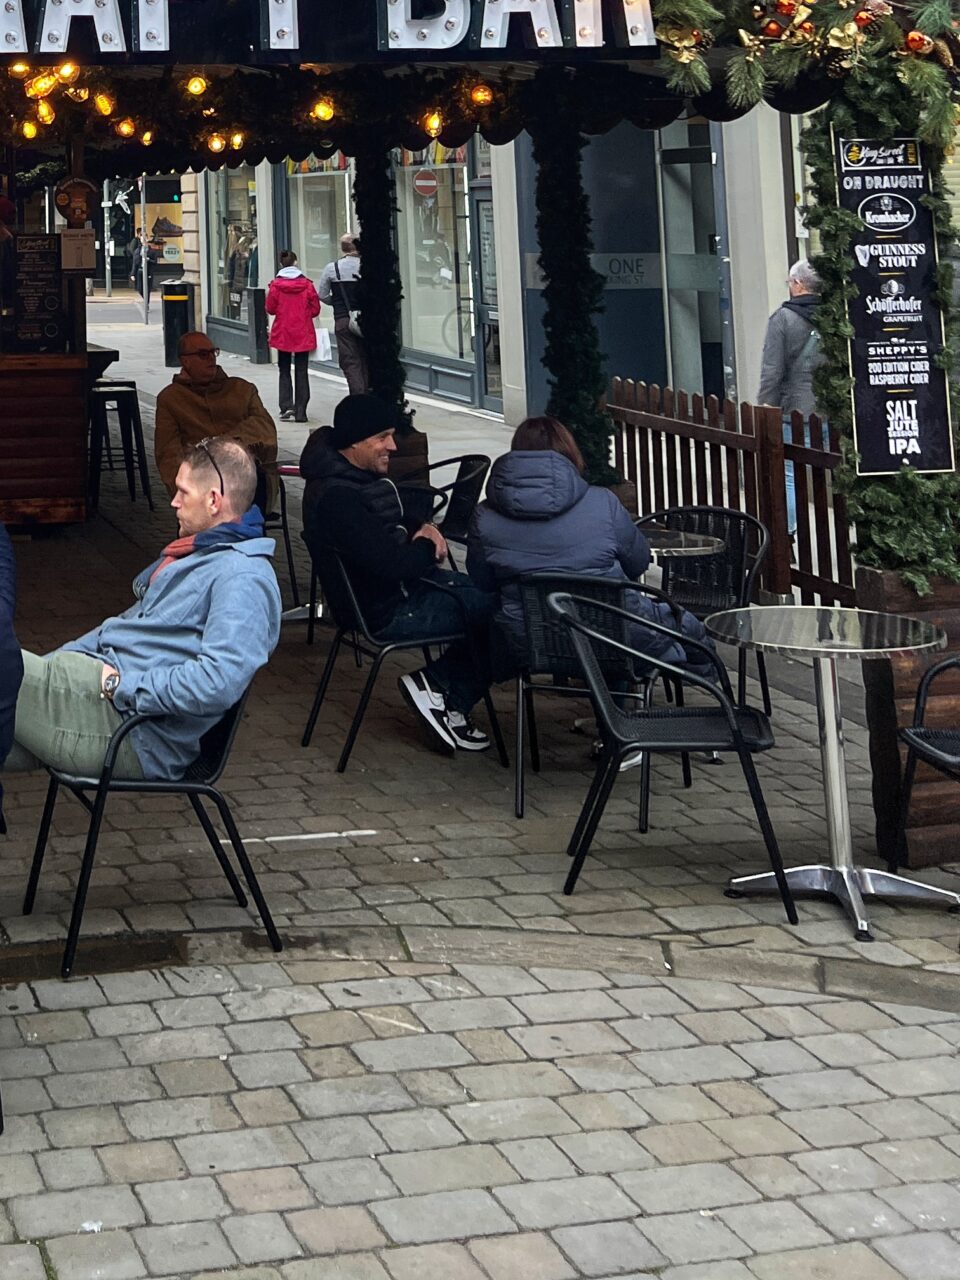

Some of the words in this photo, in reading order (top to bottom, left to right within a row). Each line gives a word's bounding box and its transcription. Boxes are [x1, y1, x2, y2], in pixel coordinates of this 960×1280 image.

[843, 176, 862, 190] ON
[864, 175, 924, 189] DRAUGHT
[865, 210, 910, 223] Krombacher
[870, 243, 926, 256] GUINNESS
[609, 258, 644, 275] ONE
[879, 255, 918, 268] STOUT
[882, 315, 923, 323] GRAPEFRUIT
[868, 346, 928, 355] SHEPPY'S
[868, 362, 882, 373] 200
[883, 361, 909, 373] EDITION
[910, 361, 930, 372] CIDER
[869, 374, 908, 386] RASPBERRY
[909, 373, 930, 384] CIDER
[886, 399, 918, 421] SALT
[887, 419, 919, 432] JUTE
[889, 438, 922, 455] IPA
